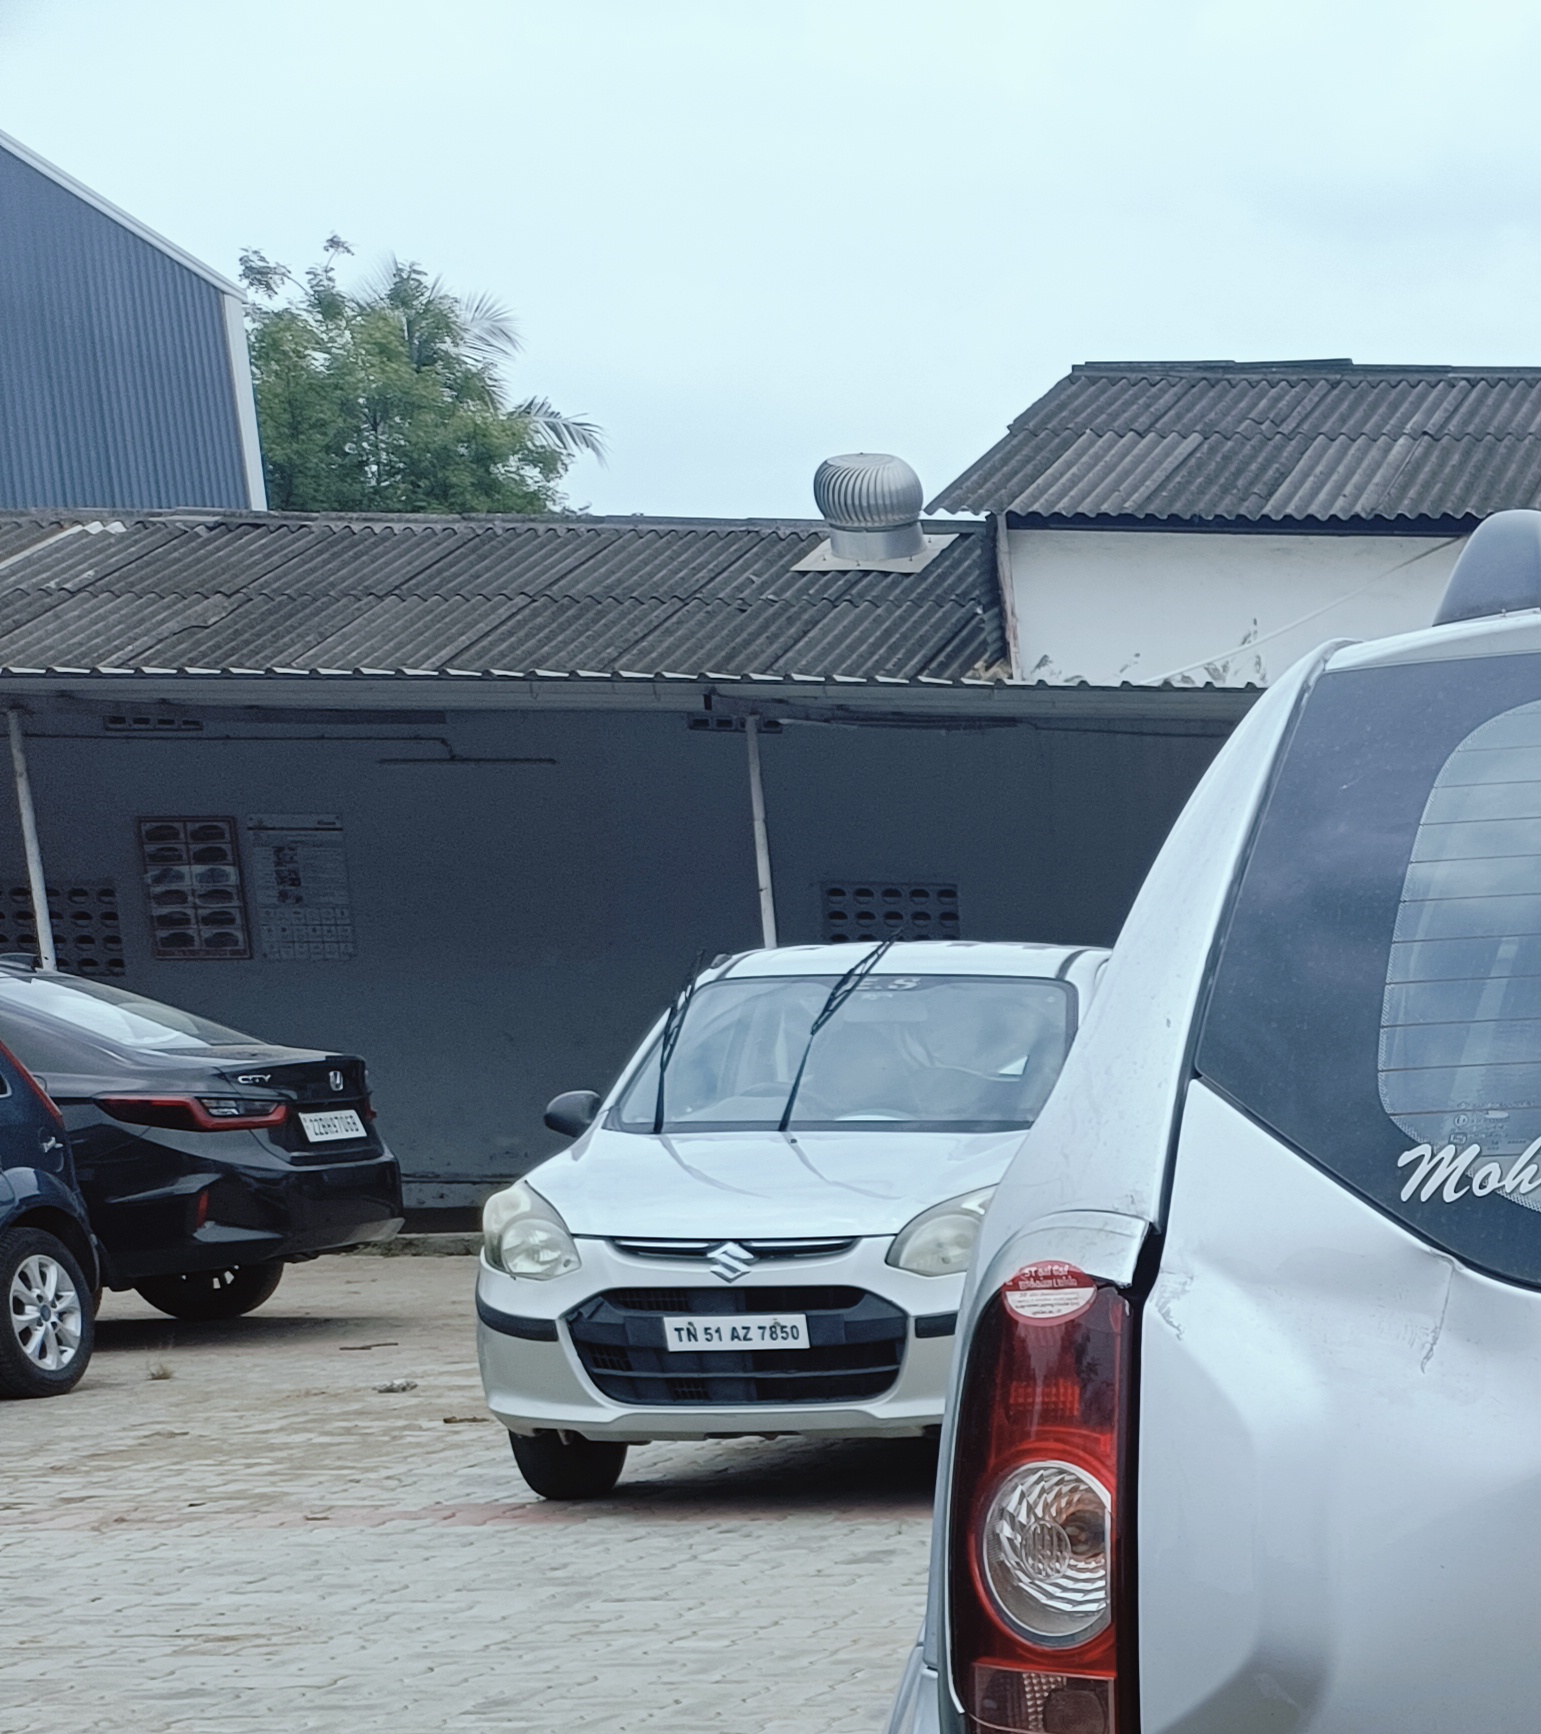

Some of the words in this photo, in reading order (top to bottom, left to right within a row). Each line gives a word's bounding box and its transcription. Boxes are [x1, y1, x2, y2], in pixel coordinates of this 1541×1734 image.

[674, 1325, 699, 1342] TN
[704, 1326, 724, 1342] 51
[730, 1325, 753, 1342] AZ
[757, 1324, 800, 1341] 7850
